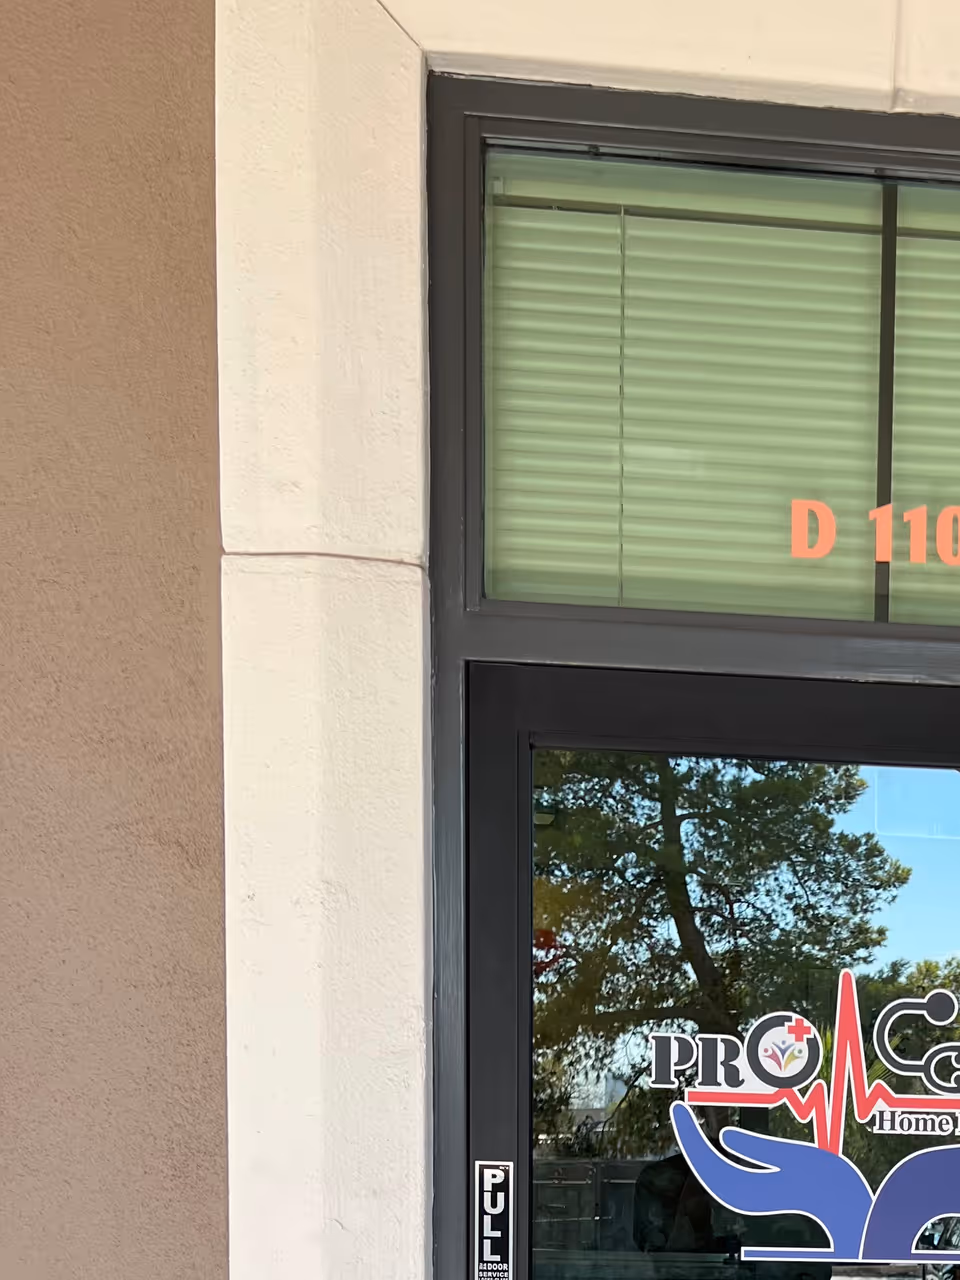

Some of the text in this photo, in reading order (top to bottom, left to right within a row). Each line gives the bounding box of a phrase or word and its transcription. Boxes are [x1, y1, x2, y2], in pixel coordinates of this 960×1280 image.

[791, 499, 836, 559] D
[650, 1013, 821, 1089] PRO
[875, 1109, 953, 1133] Home
[483, 1168, 505, 1261] PULL
[487, 1263, 508, 1271] DOOR
